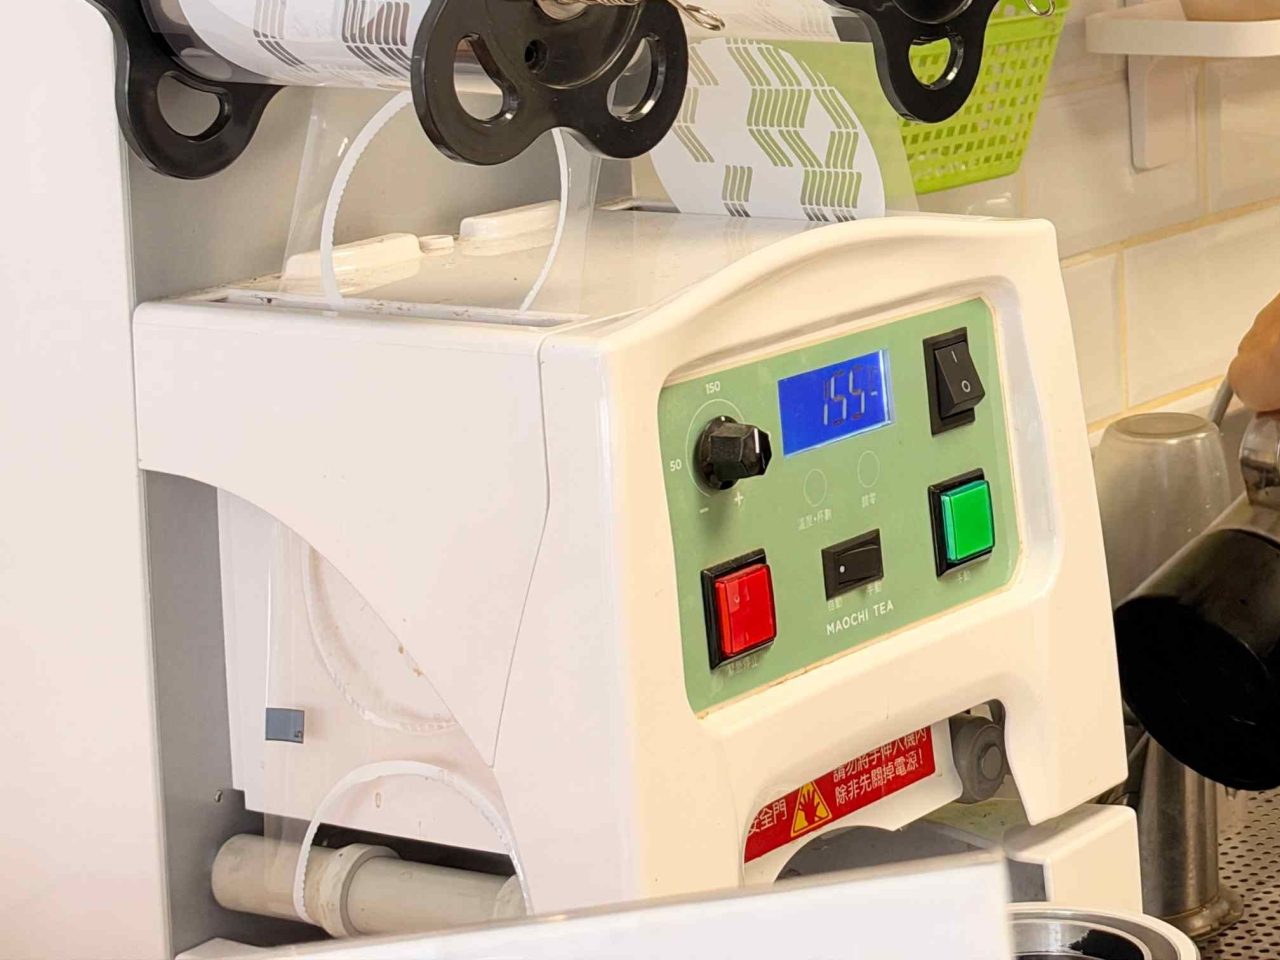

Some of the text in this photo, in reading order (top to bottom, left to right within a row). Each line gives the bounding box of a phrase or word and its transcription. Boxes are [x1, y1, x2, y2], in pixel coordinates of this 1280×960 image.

[705, 380, 721, 395] 150
[669, 459, 683, 472] 50
[826, 599, 895, 636] MAOCHI TEA
